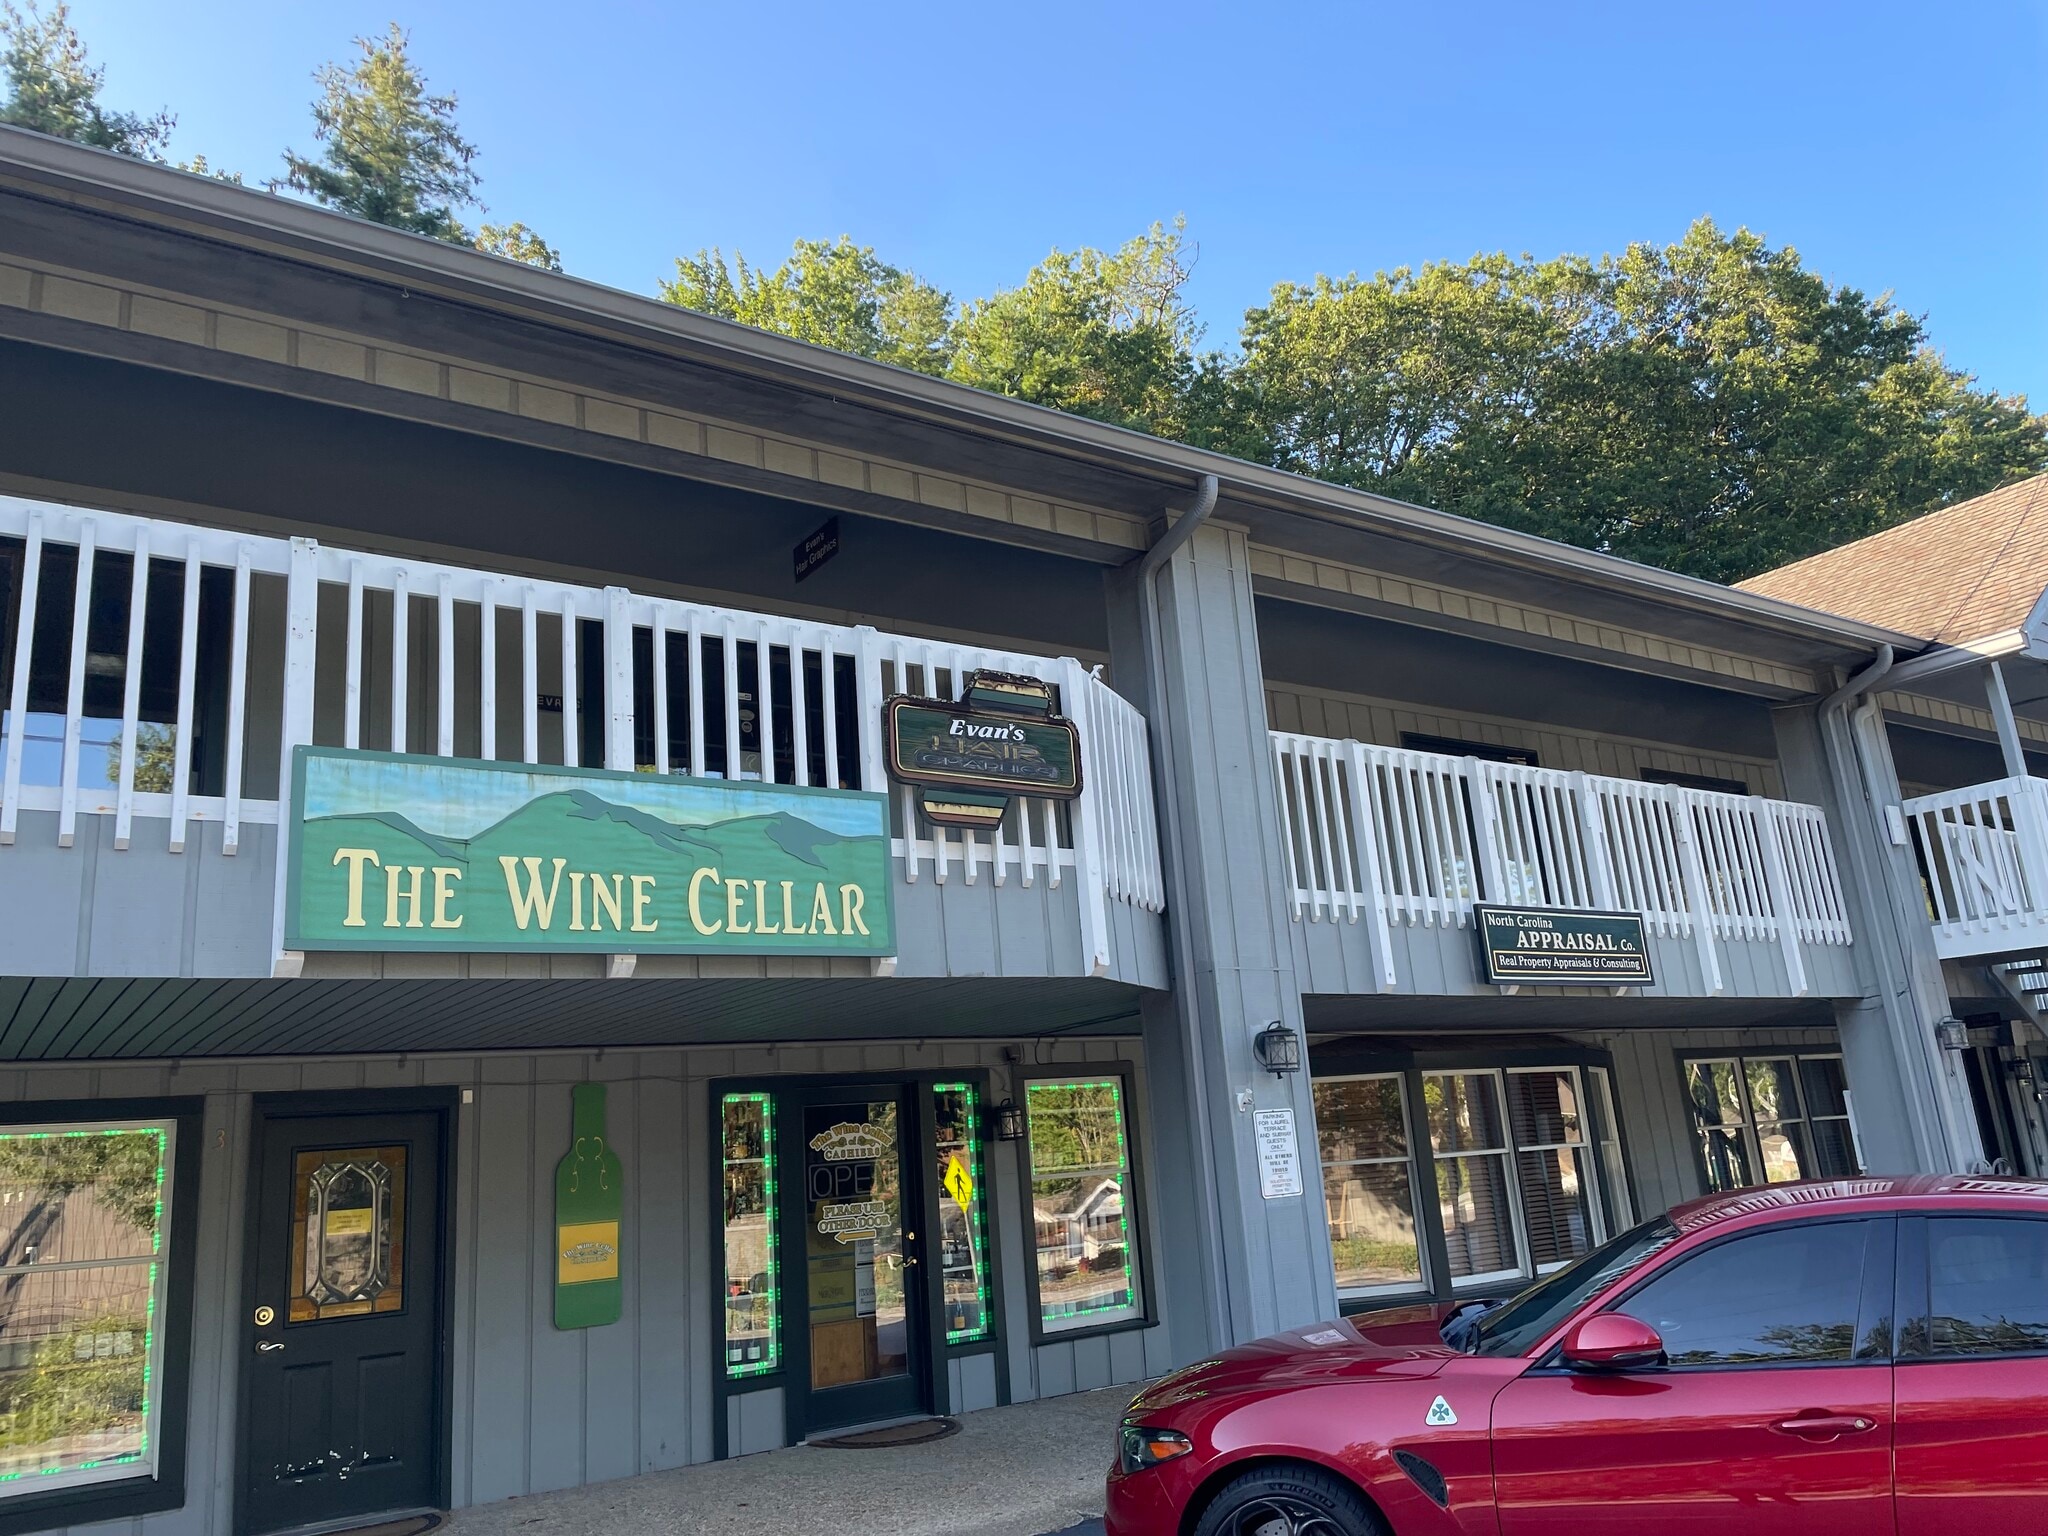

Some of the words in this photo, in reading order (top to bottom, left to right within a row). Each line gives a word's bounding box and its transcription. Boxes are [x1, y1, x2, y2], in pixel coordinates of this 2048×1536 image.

[949, 719, 1025, 742] Evan's
[333, 848, 464, 929] THE
[498, 856, 658, 932] WINE
[688, 867, 870, 936] CELLAR
[1486, 913, 1515, 928] North
[1516, 915, 1553, 929] Carolina
[1516, 930, 1618, 951] APPRAISAL
[1620, 938, 1636, 951] Co.
[1499, 955, 1518, 967] Real
[1518, 955, 1552, 969] Property
[1553, 957, 1592, 969] Appraisals
[1593, 958, 1600, 968] &
[1601, 958, 1641, 971] Consulting
[811, 1132, 833, 1150] The
[831, 1123, 860, 1136] Wine
[825, 1147, 881, 1159] CASHIERS
[824, 1204, 862, 1218] PLEASE
[863, 1201, 884, 1214] USE
[818, 1219, 857, 1232] OTHER
[858, 1216, 890, 1229] DOOR
